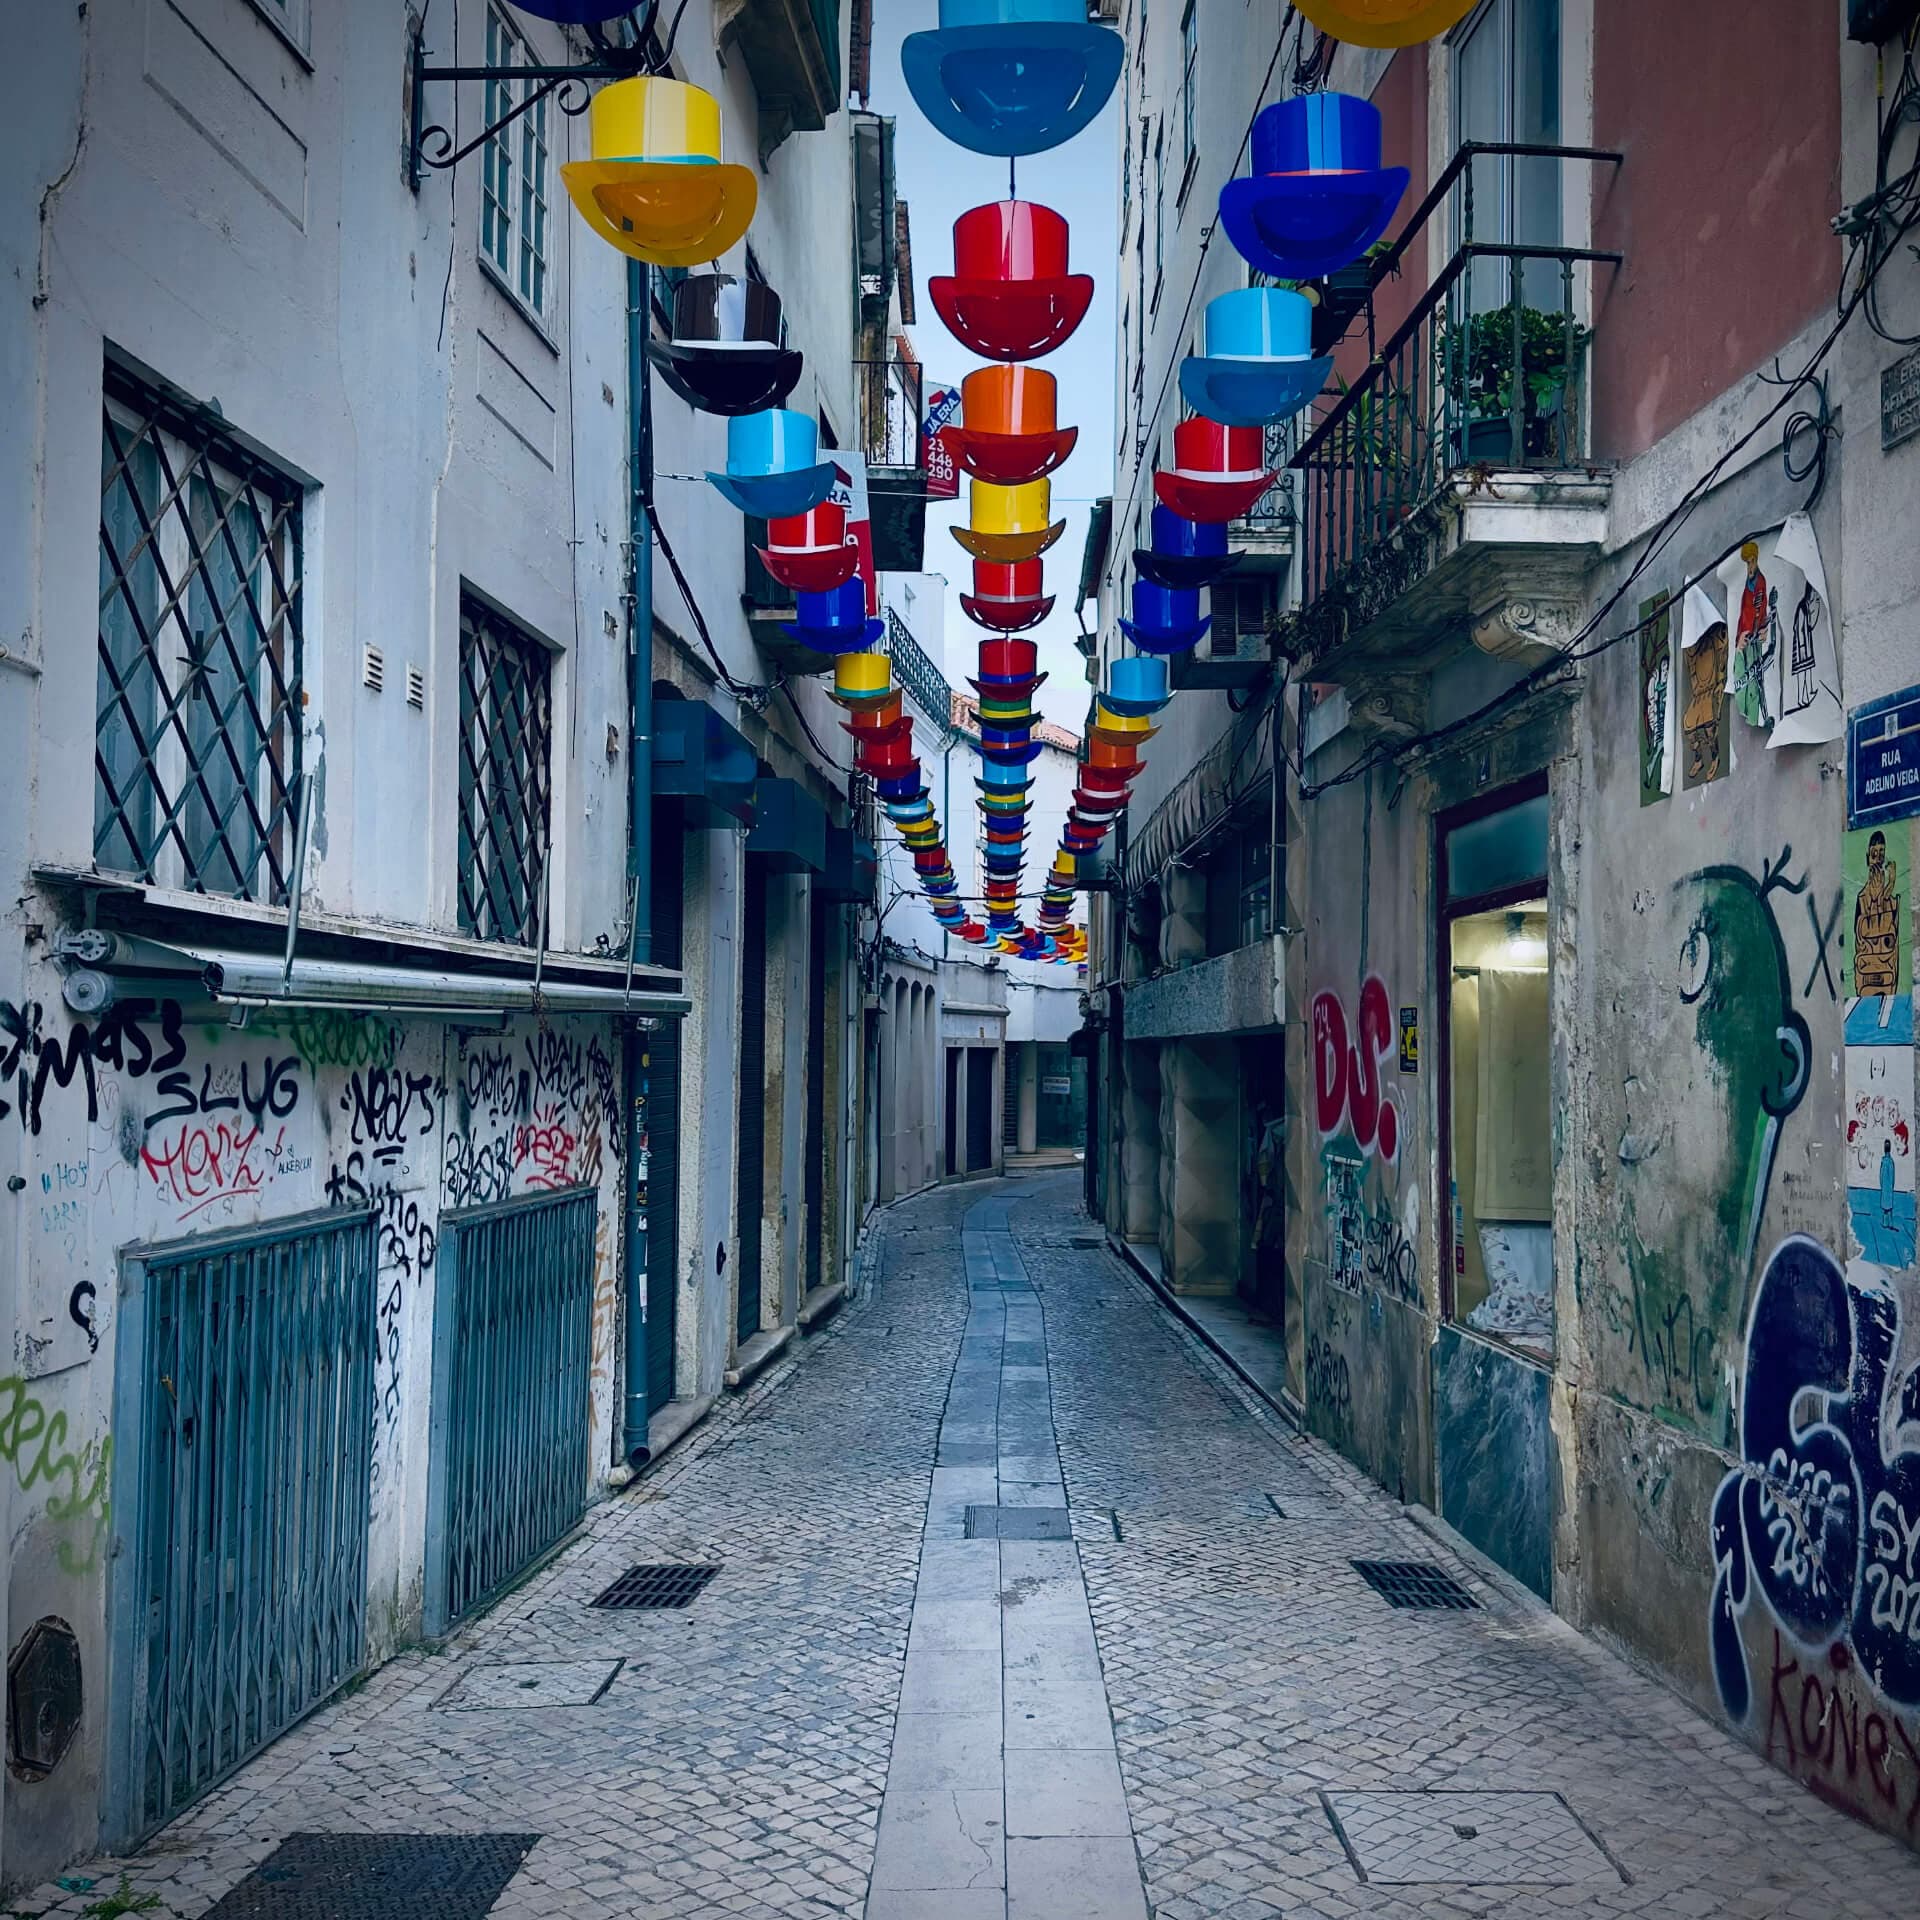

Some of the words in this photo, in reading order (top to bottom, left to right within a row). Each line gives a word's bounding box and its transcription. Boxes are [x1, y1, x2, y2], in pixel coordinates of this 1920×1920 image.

[927, 437, 945, 452] 23
[927, 451, 953, 468] 448
[927, 463, 954, 481] 290
[1881, 748, 1902, 768] RUA
[1865, 773, 1896, 795] ADELINO
[1896, 767, 1920, 787] VEIGA
[144, 1056, 301, 1134] SLUG
